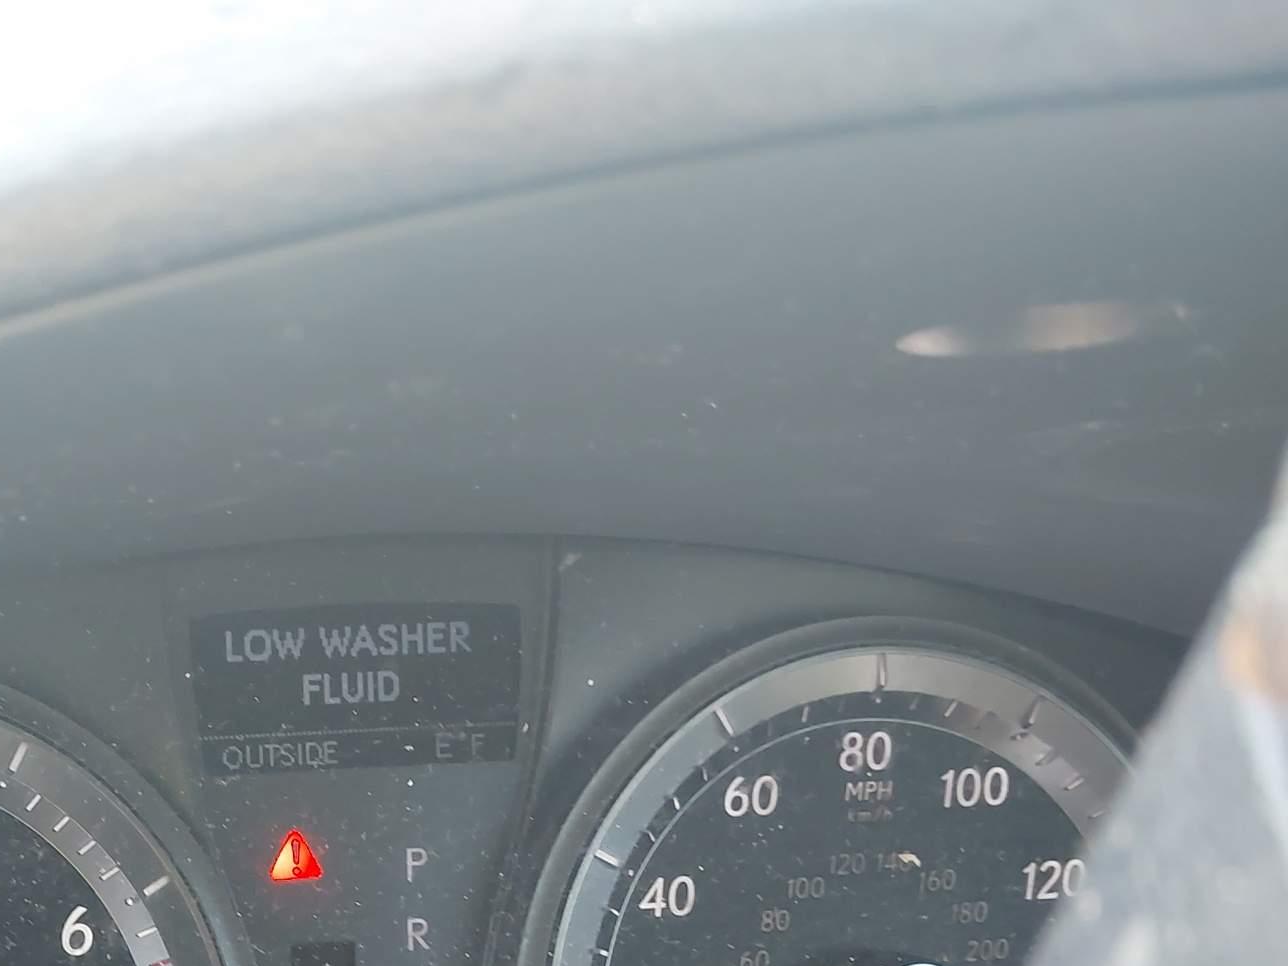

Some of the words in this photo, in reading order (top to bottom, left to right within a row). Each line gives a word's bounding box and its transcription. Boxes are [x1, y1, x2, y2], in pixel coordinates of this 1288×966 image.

[224, 627, 305, 663] LOW
[318, 620, 472, 659] WASHER
[302, 670, 400, 705] FLUID
[222, 740, 339, 770] OUTSIDE
[839, 731, 892, 772] 80
[724, 775, 779, 817] 60
[844, 780, 894, 802] MPH
[940, 767, 1009, 808] 100
[405, 847, 429, 883] P
[829, 852, 866, 876] 120
[919, 868, 957, 893] 160
[1022, 858, 1087, 901] 120
[638, 875, 696, 918] 40
[786, 876, 825, 900] 100
[761, 908, 790, 932] 80
[951, 901, 989, 924] 180
[60, 906, 96, 957] 6
[406, 917, 431, 952] R
[965, 938, 1009, 962] 200
